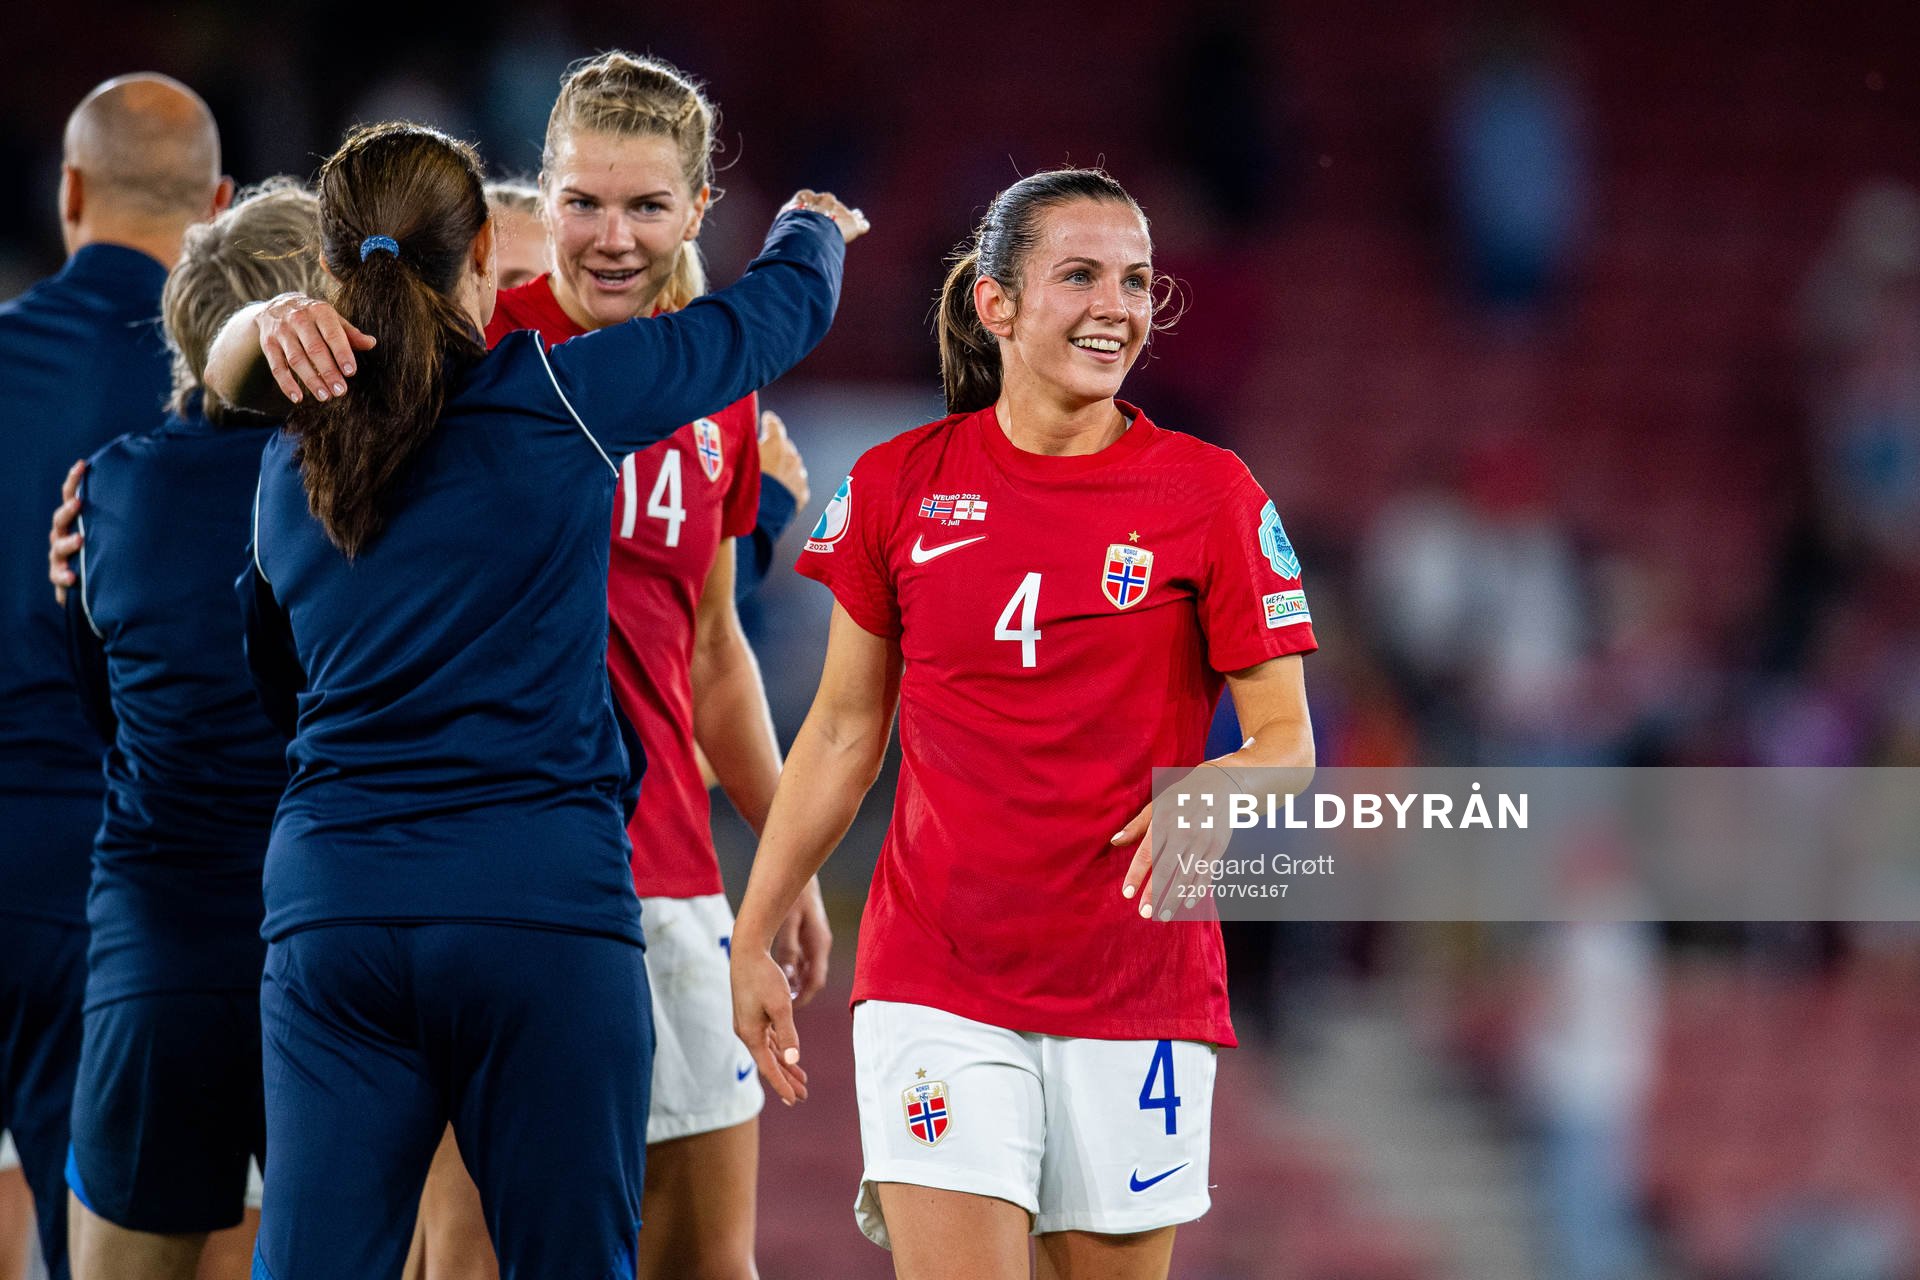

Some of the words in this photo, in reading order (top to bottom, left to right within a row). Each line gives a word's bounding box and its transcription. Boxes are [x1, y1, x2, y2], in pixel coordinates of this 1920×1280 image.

[620, 449, 687, 547] 14
[932, 493, 960, 501] WEURO
[808, 543, 828, 551] 2022
[1266, 594, 1285, 605] UEFA
[1267, 600, 1308, 616] FOUND
[994, 571, 1042, 668] 4
[1139, 1039, 1181, 1136] 4
